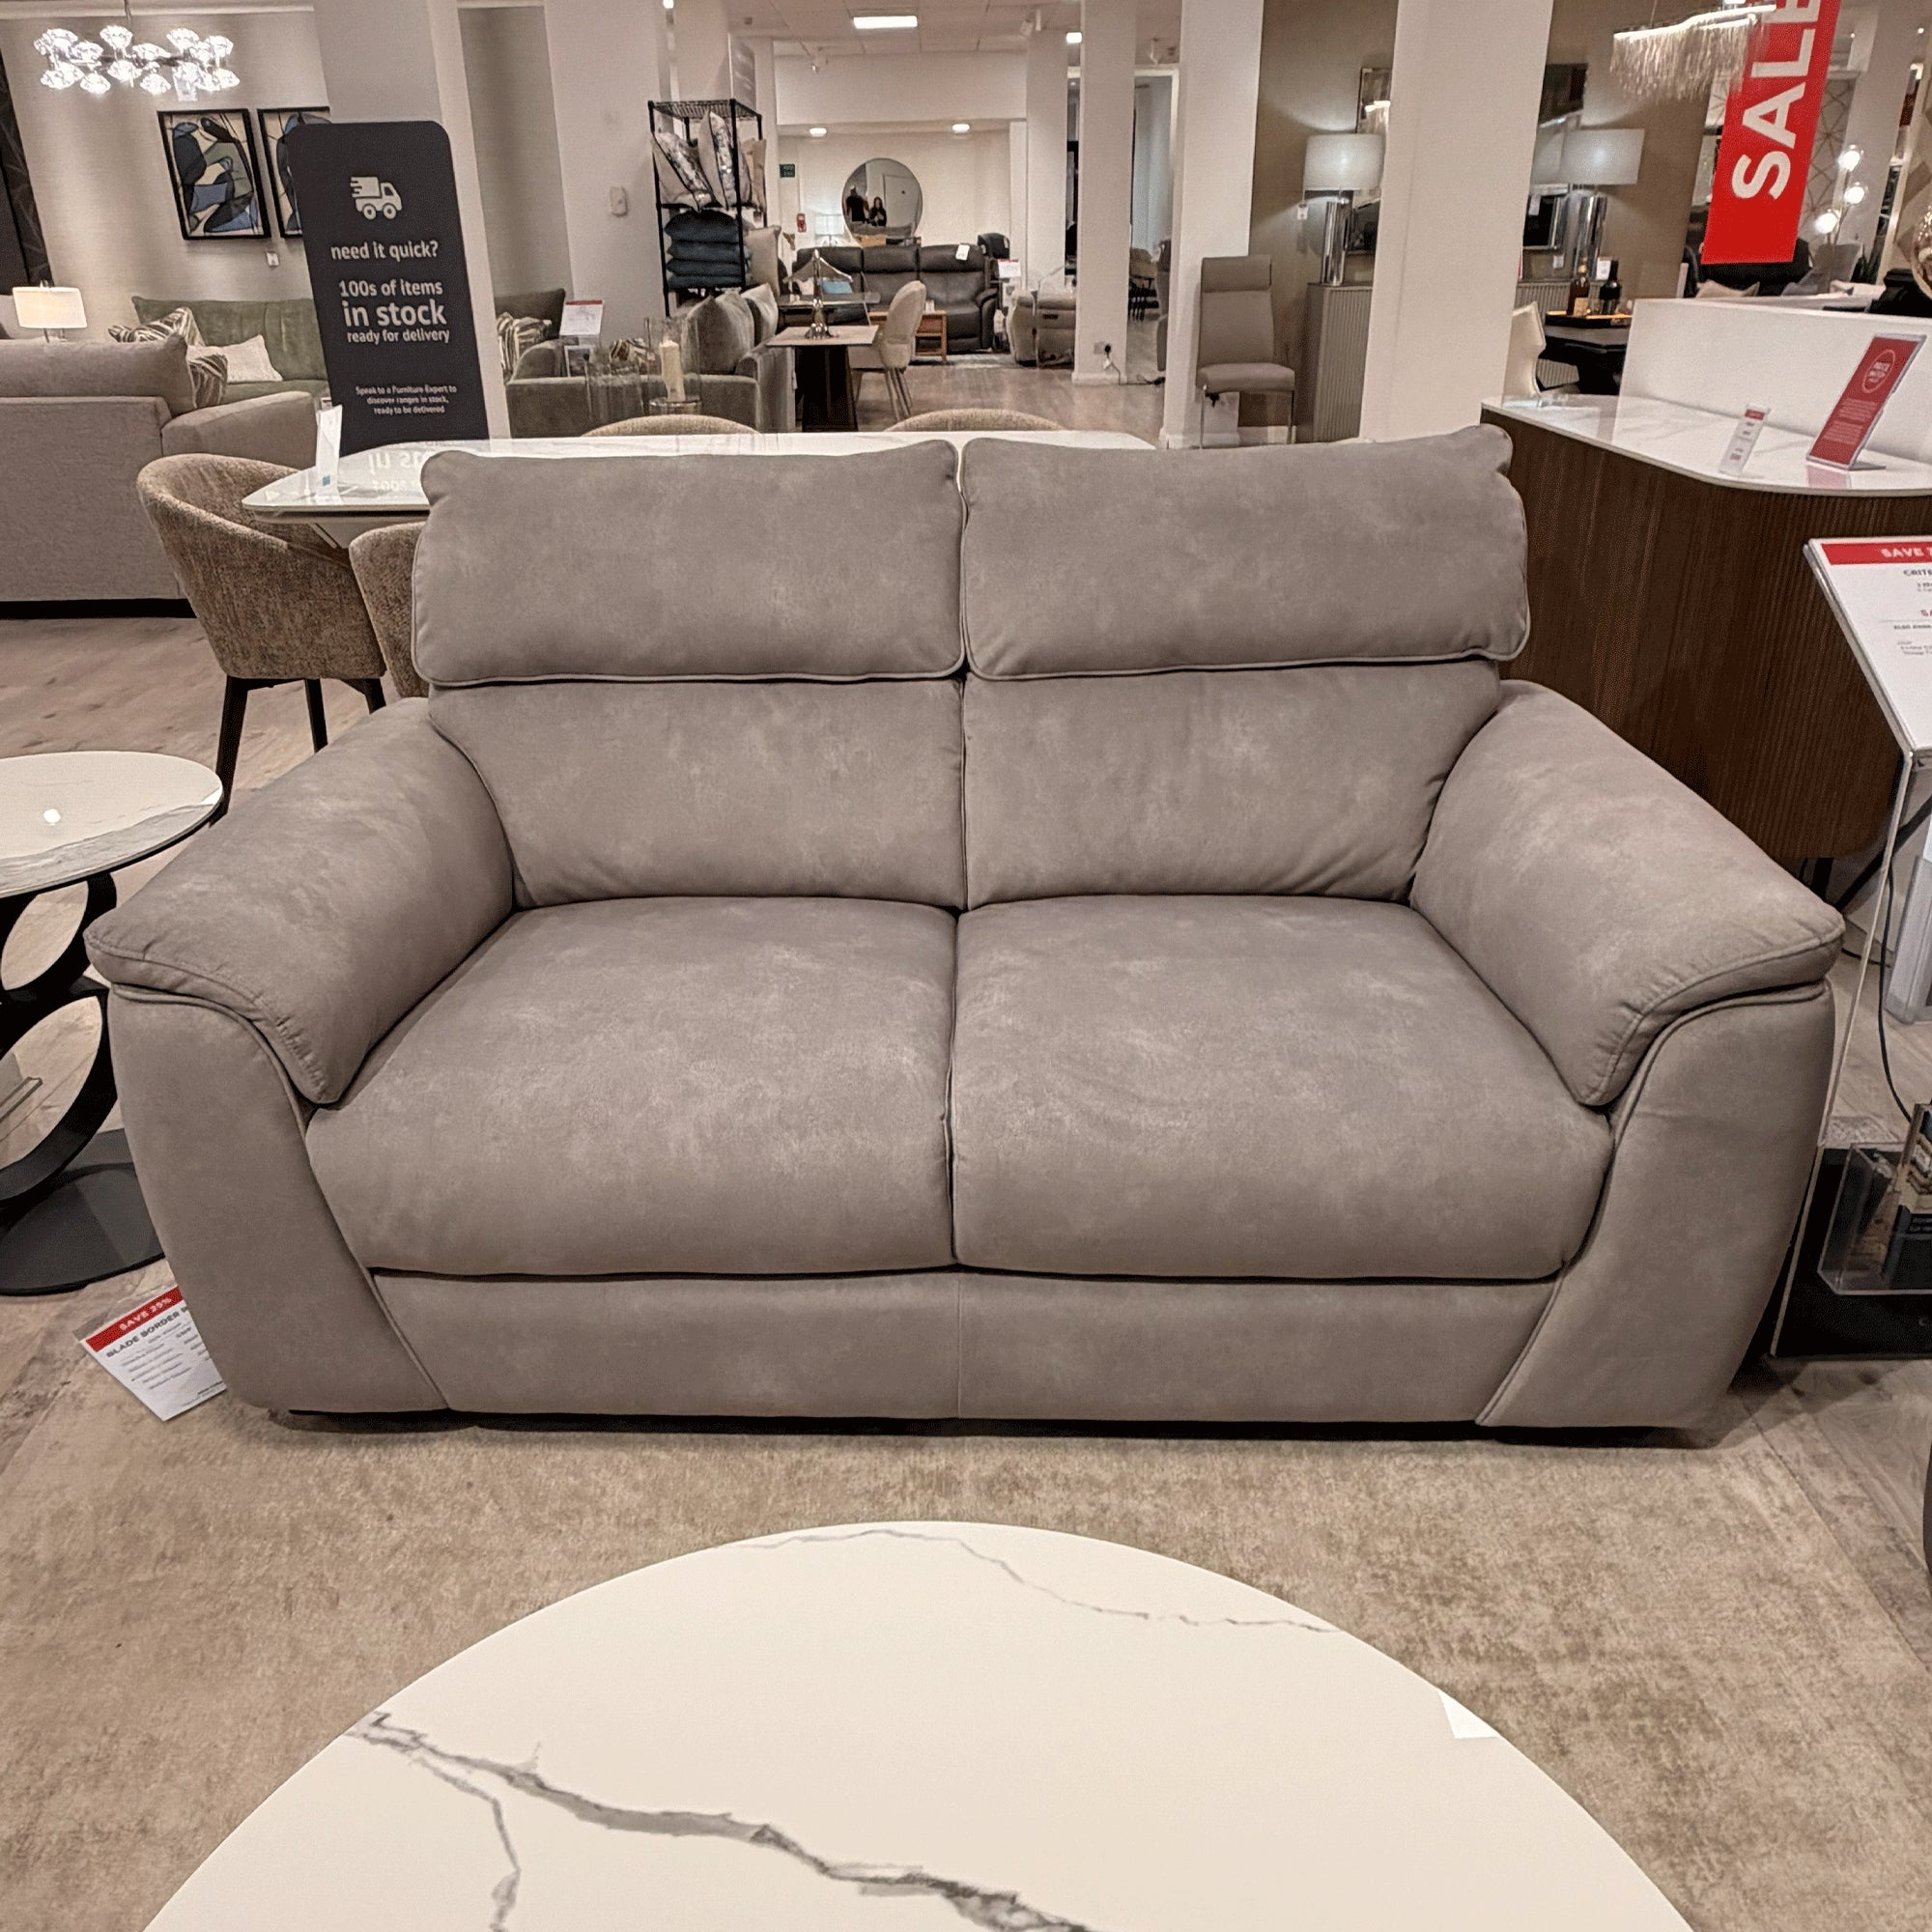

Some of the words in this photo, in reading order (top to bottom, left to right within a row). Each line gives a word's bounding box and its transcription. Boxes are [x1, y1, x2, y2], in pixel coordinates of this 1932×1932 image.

[1731, 0, 1822, 200] SALE
[330, 242, 370, 260] need
[373, 241, 386, 259] it
[388, 240, 439, 262] quick?
[338, 280, 378, 297] 100s
[380, 278, 397, 297] of
[400, 278, 443, 296] items
[341, 299, 370, 327] in
[376, 298, 447, 327] stock
[347, 329, 381, 345] ready
[382, 329, 399, 342] for
[402, 328, 450, 344] delivery
[355, 385, 377, 396] Speak
[377, 385, 385, 395] to
[391, 384, 424, 395] Furniture
[424, 384, 448, 394] Expert
[448, 384, 458, 394] to
[366, 396, 395, 405] discover
[396, 396, 419, 406] ranges
[420, 395, 428, 404] in
[373, 406, 393, 415] ready
[394, 406, 402, 414] to
[402, 406, 412, 414] be
[412, 405, 445, 414] delivered
[1880, 546, 1925, 558] SAVE
[118, 1310, 150, 1331] SAVE
[105, 1335, 140, 1358] BLADE
[139, 1311, 181, 1338] BORDER
